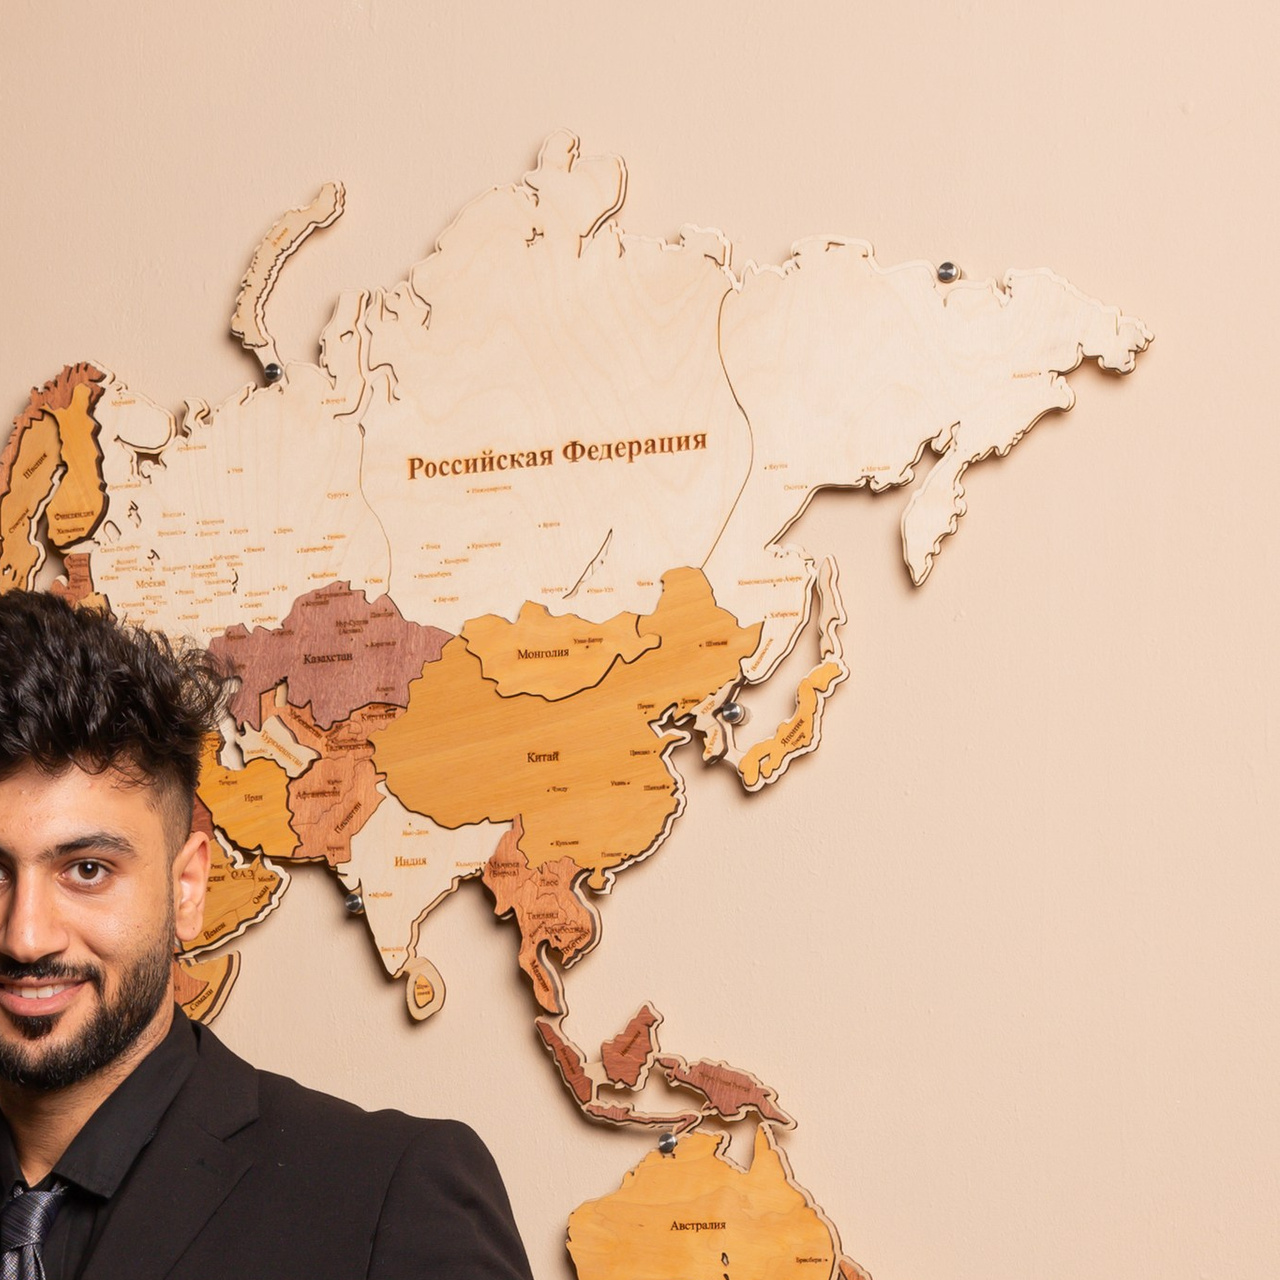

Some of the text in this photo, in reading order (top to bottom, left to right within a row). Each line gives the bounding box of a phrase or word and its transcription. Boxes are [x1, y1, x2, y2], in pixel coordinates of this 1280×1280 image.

[407, 431, 709, 481] Российская Федерация
[23, 452, 48, 480] Швеция
[54, 510, 95, 522] Финляндия
[136, 580, 166, 590] Москва
[303, 653, 354, 665] Казахстан
[517, 648, 570, 661] Монголия
[781, 717, 805, 747] Япония
[261, 729, 304, 768] Туркменистан
[527, 751, 560, 764] Китай
[244, 793, 263, 803] Иран
[334, 802, 362, 835] Пакистан
[395, 856, 428, 868] Индия
[252, 884, 269, 906] Оман
[204, 922, 226, 941] Йемен
[189, 988, 215, 1012] Сомали
[670, 1219, 727, 1233] Австралия
